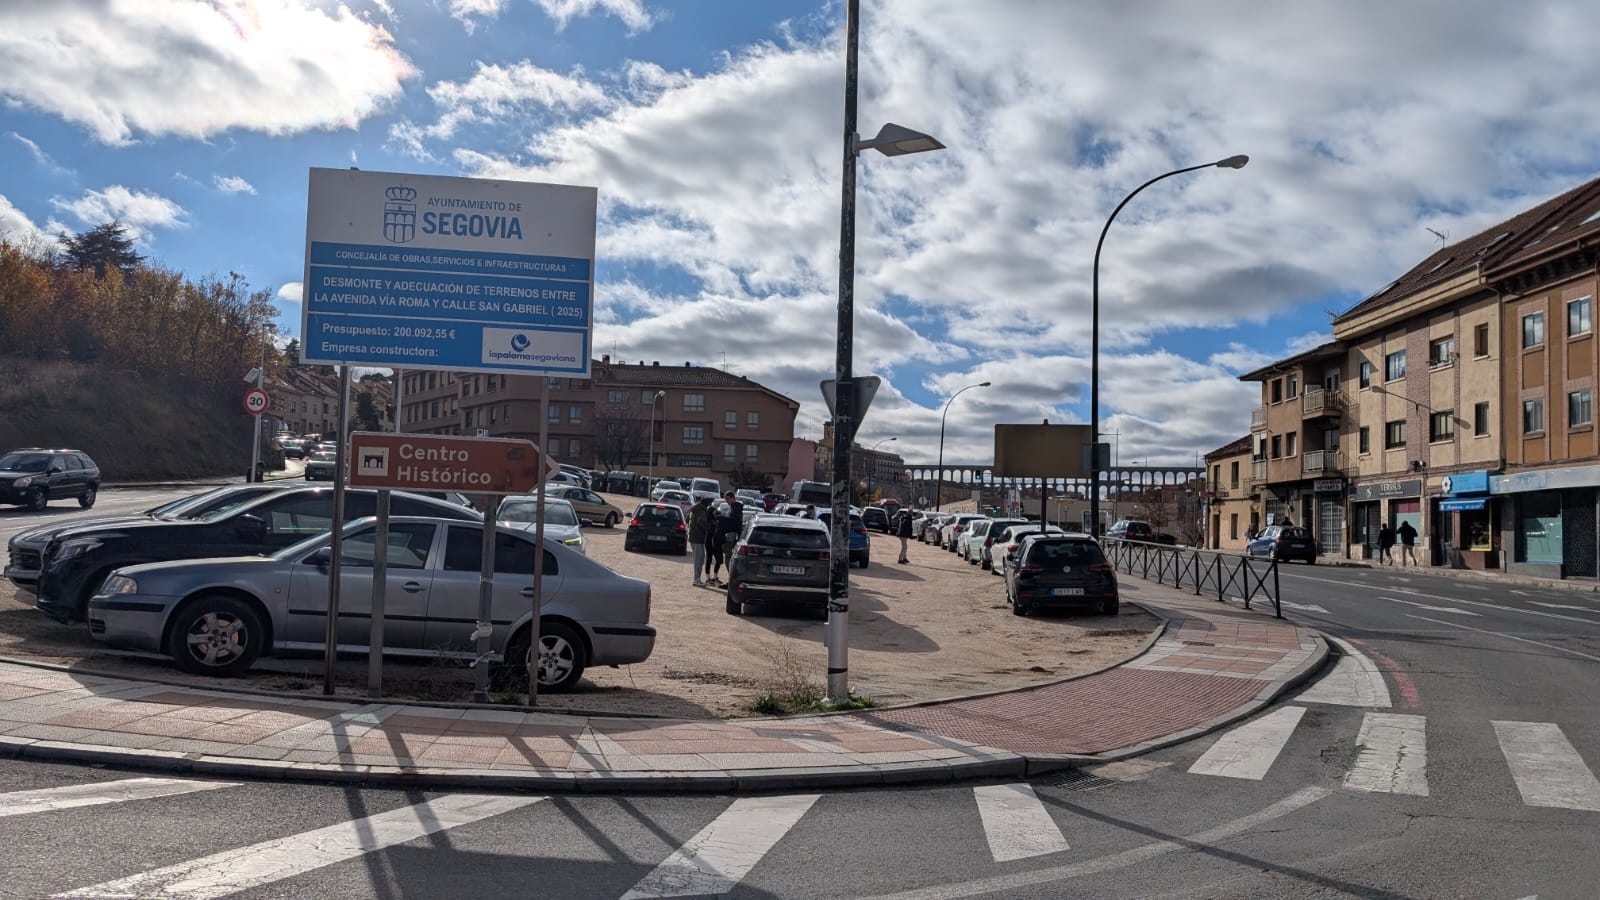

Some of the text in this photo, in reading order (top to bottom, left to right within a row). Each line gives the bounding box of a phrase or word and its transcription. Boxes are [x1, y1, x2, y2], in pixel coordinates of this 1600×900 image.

[427, 197, 522, 212] AYUNTAMIENTO DE
[422, 211, 522, 240] SEGOVIA
[336, 250, 387, 261] CONCEJALÍA
[476, 258, 482, 266] E
[484, 260, 566, 272] INFRAESTRUCTURAS
[323, 276, 576, 300] DESMONTE Y ADECUACIÓN DE TERRENOS ENTRE
[314, 293, 328, 302] LA
[330, 294, 376, 305] AVENIDA
[379, 294, 396, 306] VÍA
[398, 297, 430, 308] ROMA
[432, 300, 440, 308] Y
[442, 300, 476, 310] CALLE
[478, 302, 500, 312] SAN
[503, 303, 548, 314] GABRIEL
[322, 323, 391, 336] Presupuesto:
[394, 327, 446, 339] 200.092,55
[322, 342, 438, 357] Empresa constructora:
[488, 350, 576, 362] lapalomasegoviana
[250, 396, 263, 406] 30
[400, 444, 469, 462] Centro
[397, 465, 492, 484] Histórico
